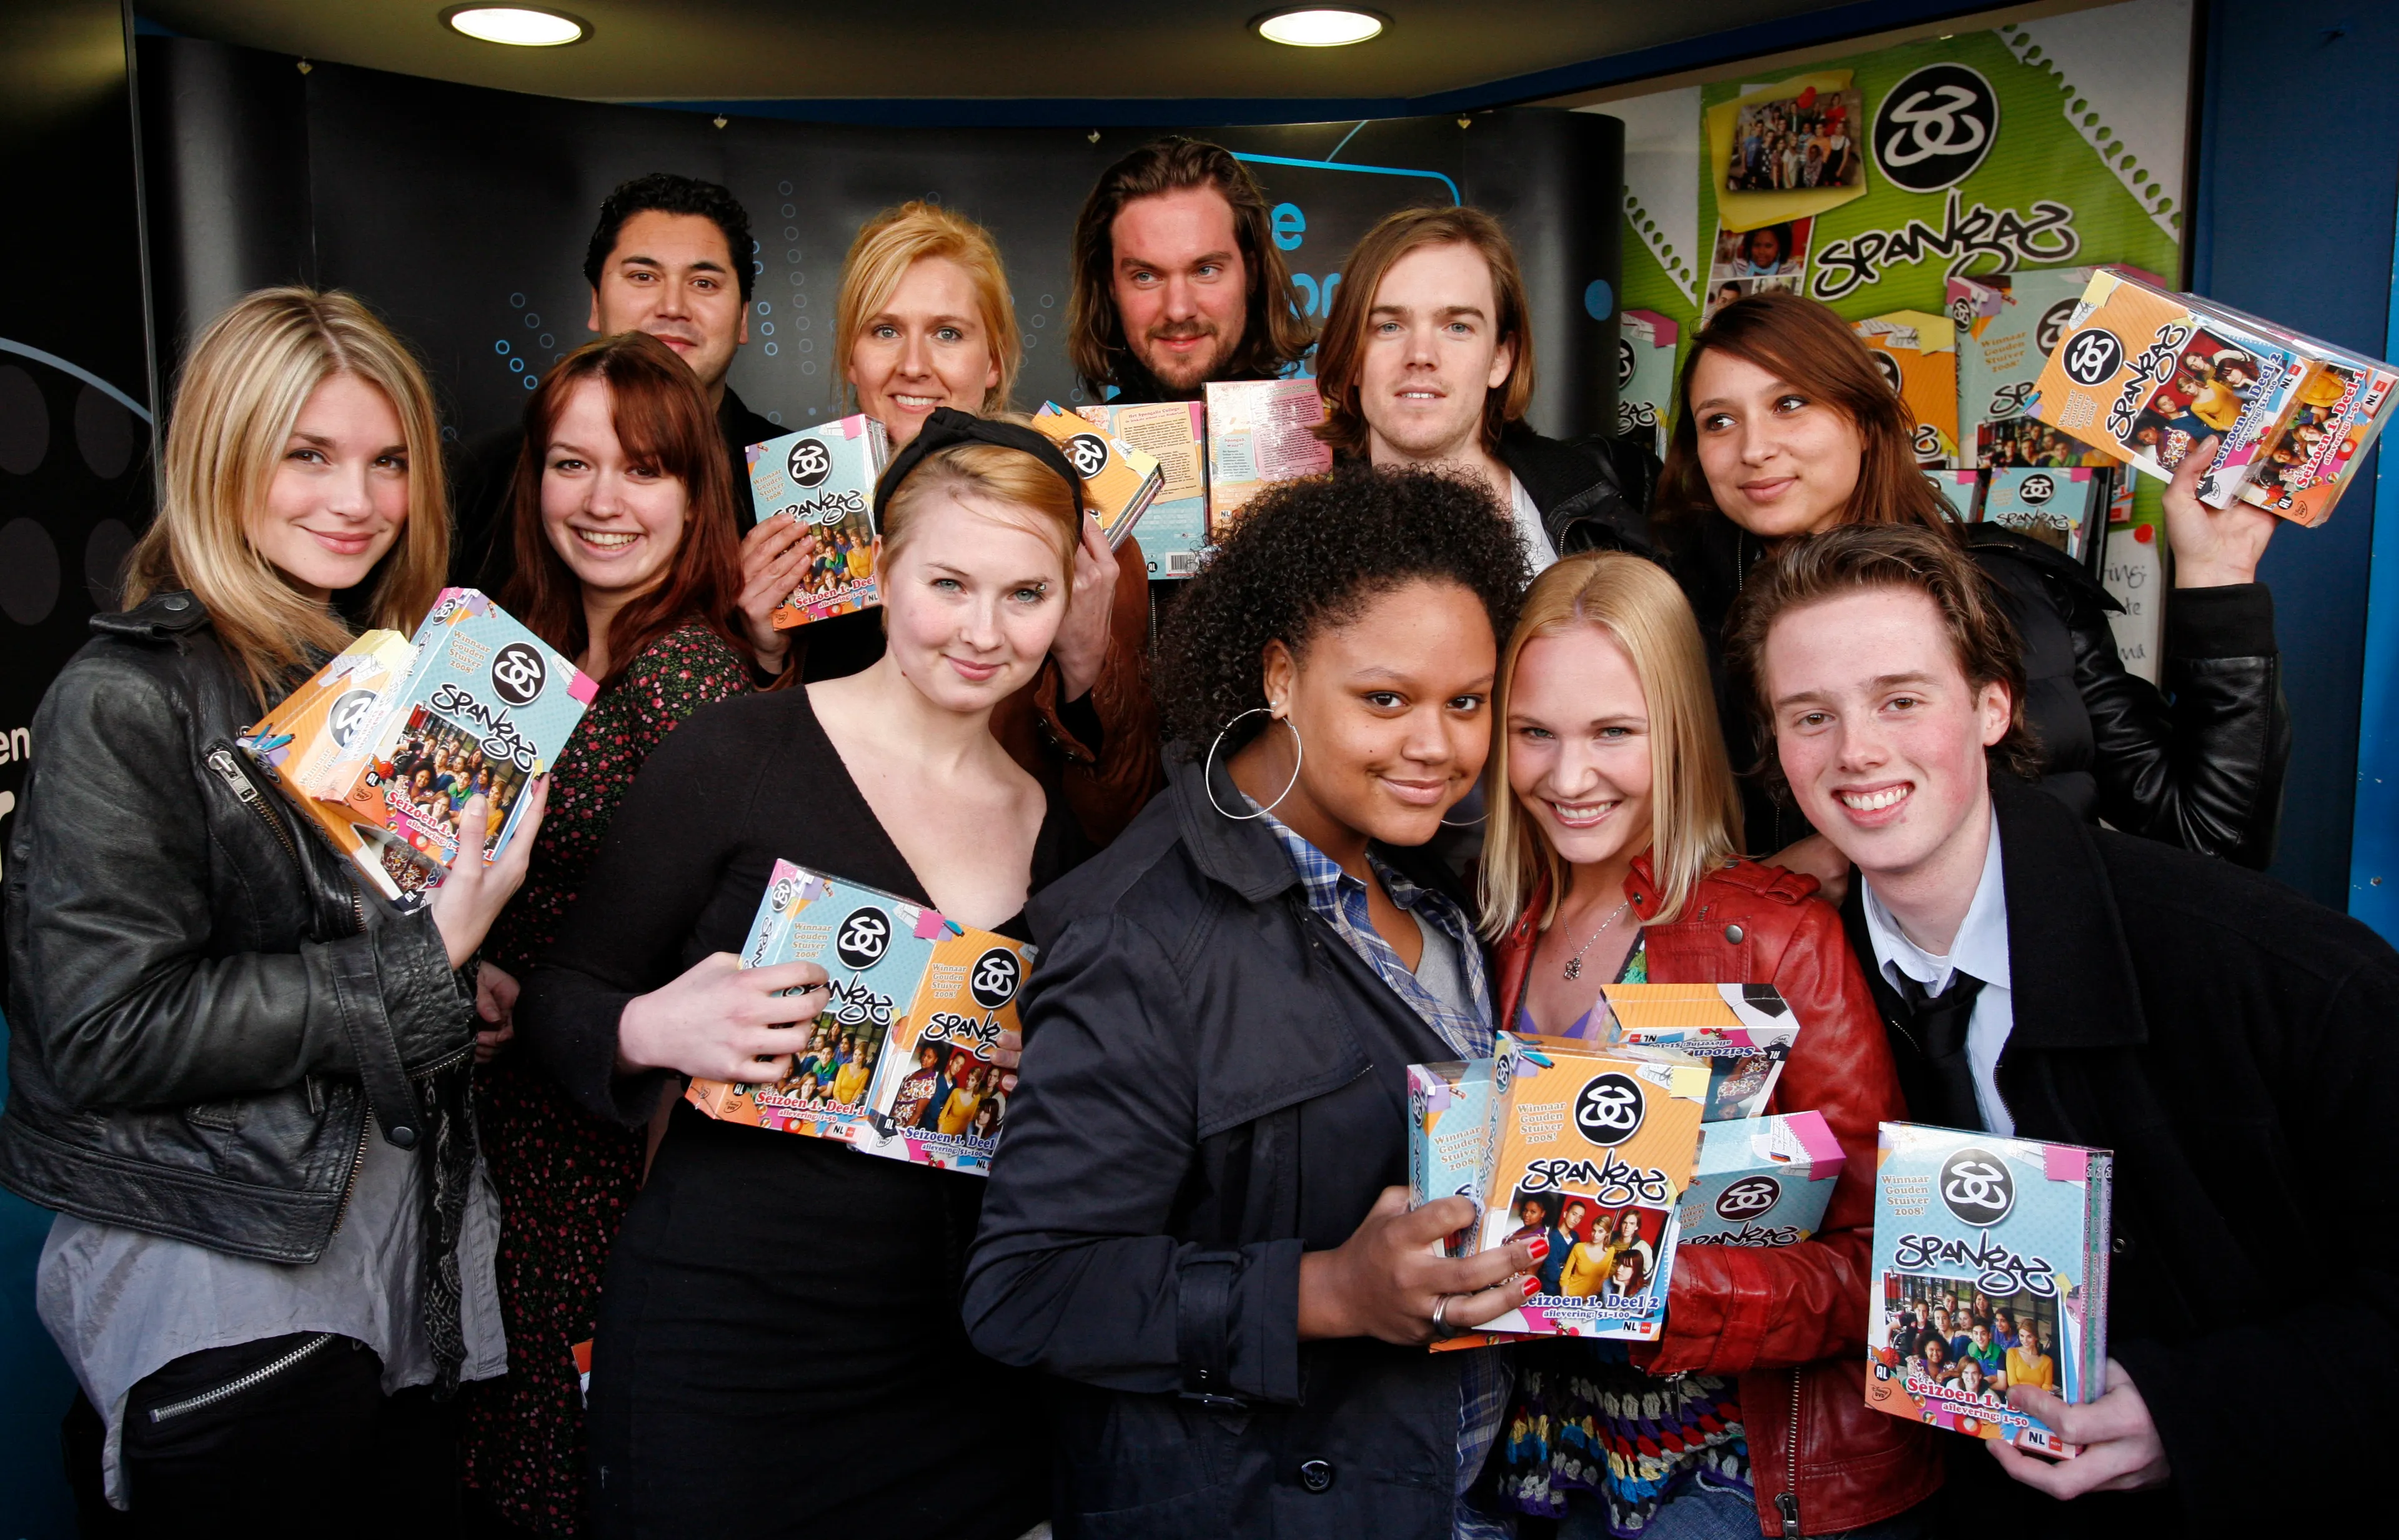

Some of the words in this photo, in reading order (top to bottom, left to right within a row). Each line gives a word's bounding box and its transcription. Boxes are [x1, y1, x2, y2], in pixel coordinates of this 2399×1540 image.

[2280, 376, 2293, 390] NL
[2365, 394, 2378, 405] NL
[2059, 390, 2076, 427] Winnaar
[2067, 393, 2084, 427] Gouden
[2212, 415, 2246, 468] Seizoen
[2249, 365, 2274, 399] Deel
[2270, 353, 2282, 364] 2
[2296, 434, 2332, 488] Seizoen
[2333, 382, 2360, 416] Deel
[753, 469, 782, 485] Winnaar
[757, 476, 783, 491] Gouden
[759, 482, 785, 497] Stuiver
[2280, 498, 2292, 509] AL
[795, 590, 837, 607] Seizoen
[453, 630, 490, 653] Winnaar
[451, 640, 485, 661] Gouden
[449, 648, 482, 668] Stuiver
[449, 660, 475, 675] 2008!
[367, 773, 379, 785] AL
[387, 792, 439, 828] Seizoen
[407, 820, 447, 845] aflevering:
[405, 890, 417, 902] AL
[793, 923, 832, 931] Winnaar
[794, 932, 828, 940] Gouden
[792, 941, 826, 950] Stuiver
[795, 950, 819, 958] 2008!
[932, 963, 966, 972] Winnaar
[933, 973, 963, 981] Gouden
[931, 981, 962, 990] Stuiver
[1694, 1046, 1756, 1058] Seizoen
[755, 1091, 810, 1109] Seizoen
[811, 1100, 822, 1110] 1.
[826, 1101, 855, 1114] Deel
[1517, 1101, 1566, 1114] Winnaar
[778, 1108, 819, 1121] aflevering:
[1519, 1111, 1564, 1123] Gouden
[833, 1125, 844, 1134] NL
[884, 1118, 894, 1130] AL
[1520, 1122, 1563, 1134] Stuiver
[905, 1126, 951, 1144] Seizoen
[954, 1135, 965, 1146] 1.
[968, 1135, 996, 1150] Deel
[1434, 1126, 1481, 1145] Winnaar
[1526, 1132, 1557, 1143] 2008!
[921, 1143, 958, 1155] aflevering:
[959, 1149, 983, 1158] 51-100
[1439, 1137, 1480, 1154] Gouden
[976, 1160, 986, 1169] NL
[1881, 1175, 1930, 1184] Winnaar
[1885, 1186, 1929, 1195] Gouden
[1887, 1196, 1929, 1206] Stuiver
[1894, 1207, 1925, 1216] 2008!
[1587, 1296, 1602, 1308] 1.
[1607, 1294, 1644, 1308] Deel
[1649, 1297, 1659, 1309] 2
[1544, 1309, 1594, 1318] aflevering:
[1624, 1321, 1636, 1331] NL
[1876, 1365, 1888, 1379] AL
[1906, 1377, 1978, 1404] Seizoen
[1984, 1394, 2001, 1409] 1.
[1943, 1403, 2002, 1424] aflevering:
[2003, 1414, 2029, 1428] 1-50
[2029, 1431, 2045, 1446] NL
